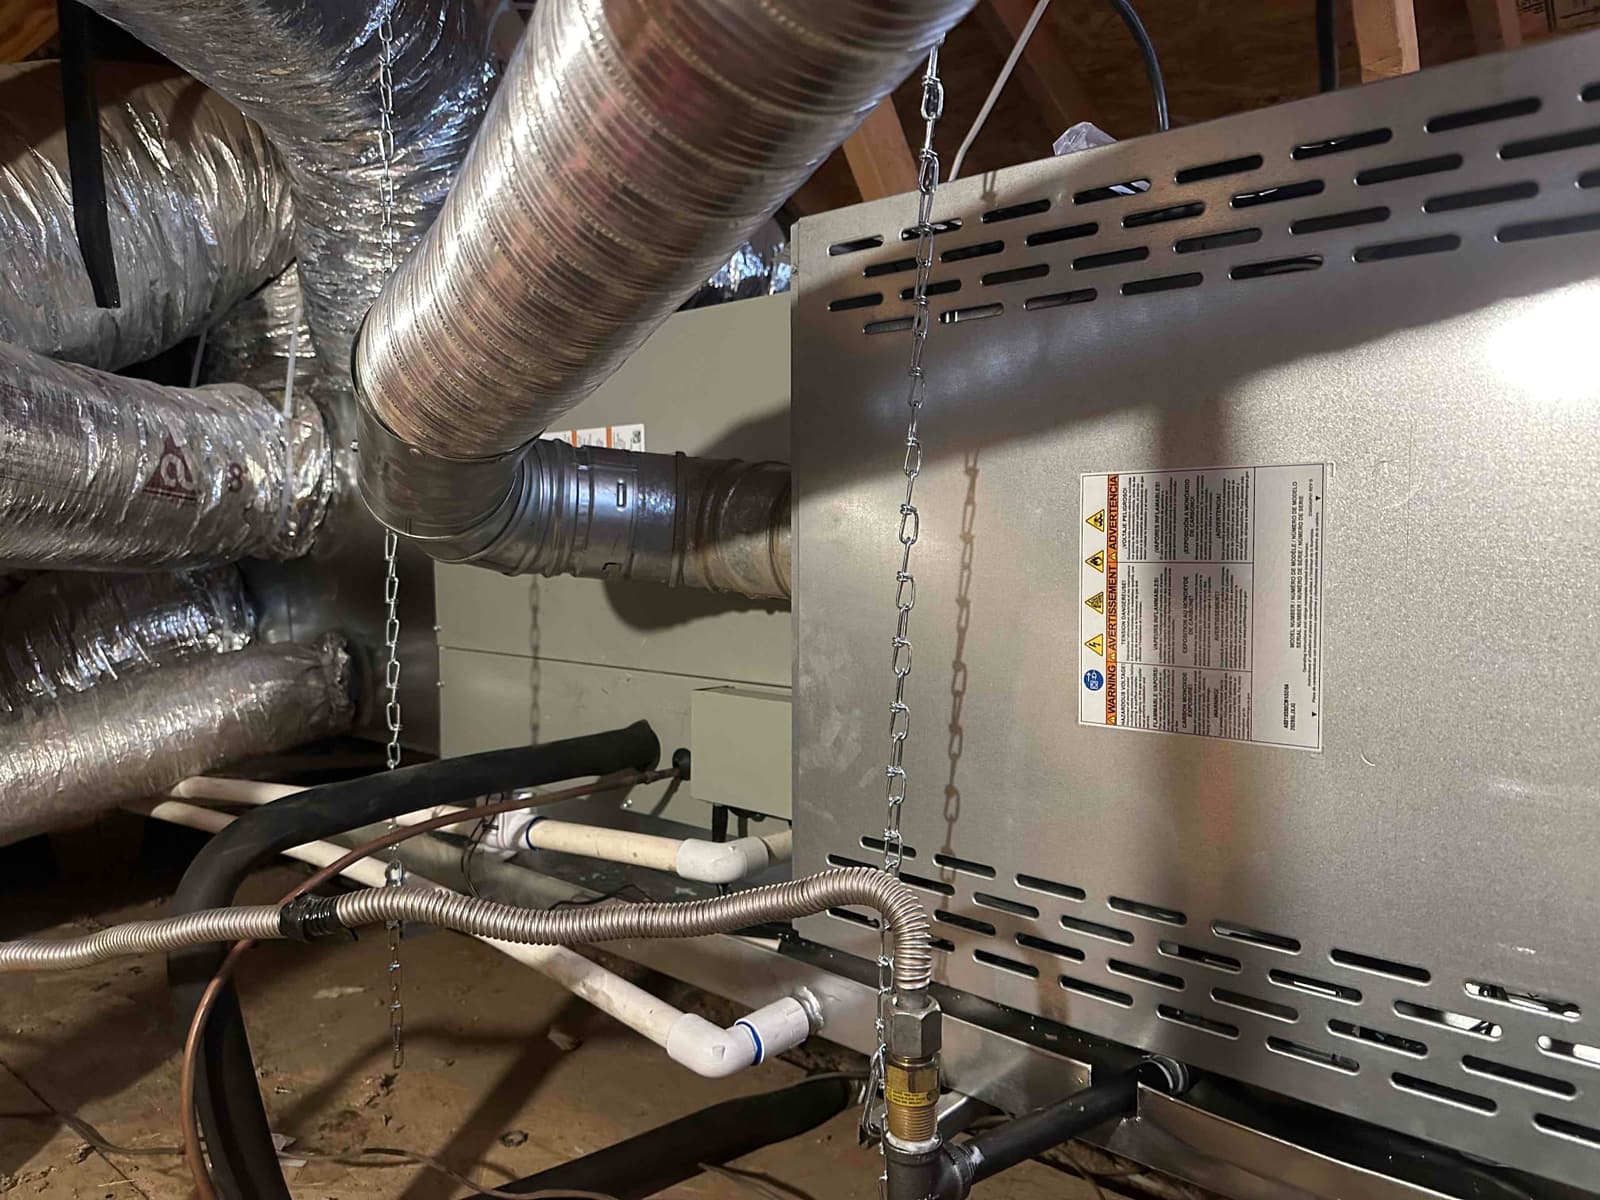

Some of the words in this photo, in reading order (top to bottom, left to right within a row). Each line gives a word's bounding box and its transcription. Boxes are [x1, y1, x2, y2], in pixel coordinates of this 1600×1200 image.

[1109, 476, 1118, 550] ADVERTENCIA
[1298, 512, 1303, 520] DE
[1190, 529, 1194, 537] DE
[1109, 565, 1117, 651] AVERTISSEMENT
[1188, 627, 1193, 635] DE
[1108, 665, 1116, 714] WARNING
